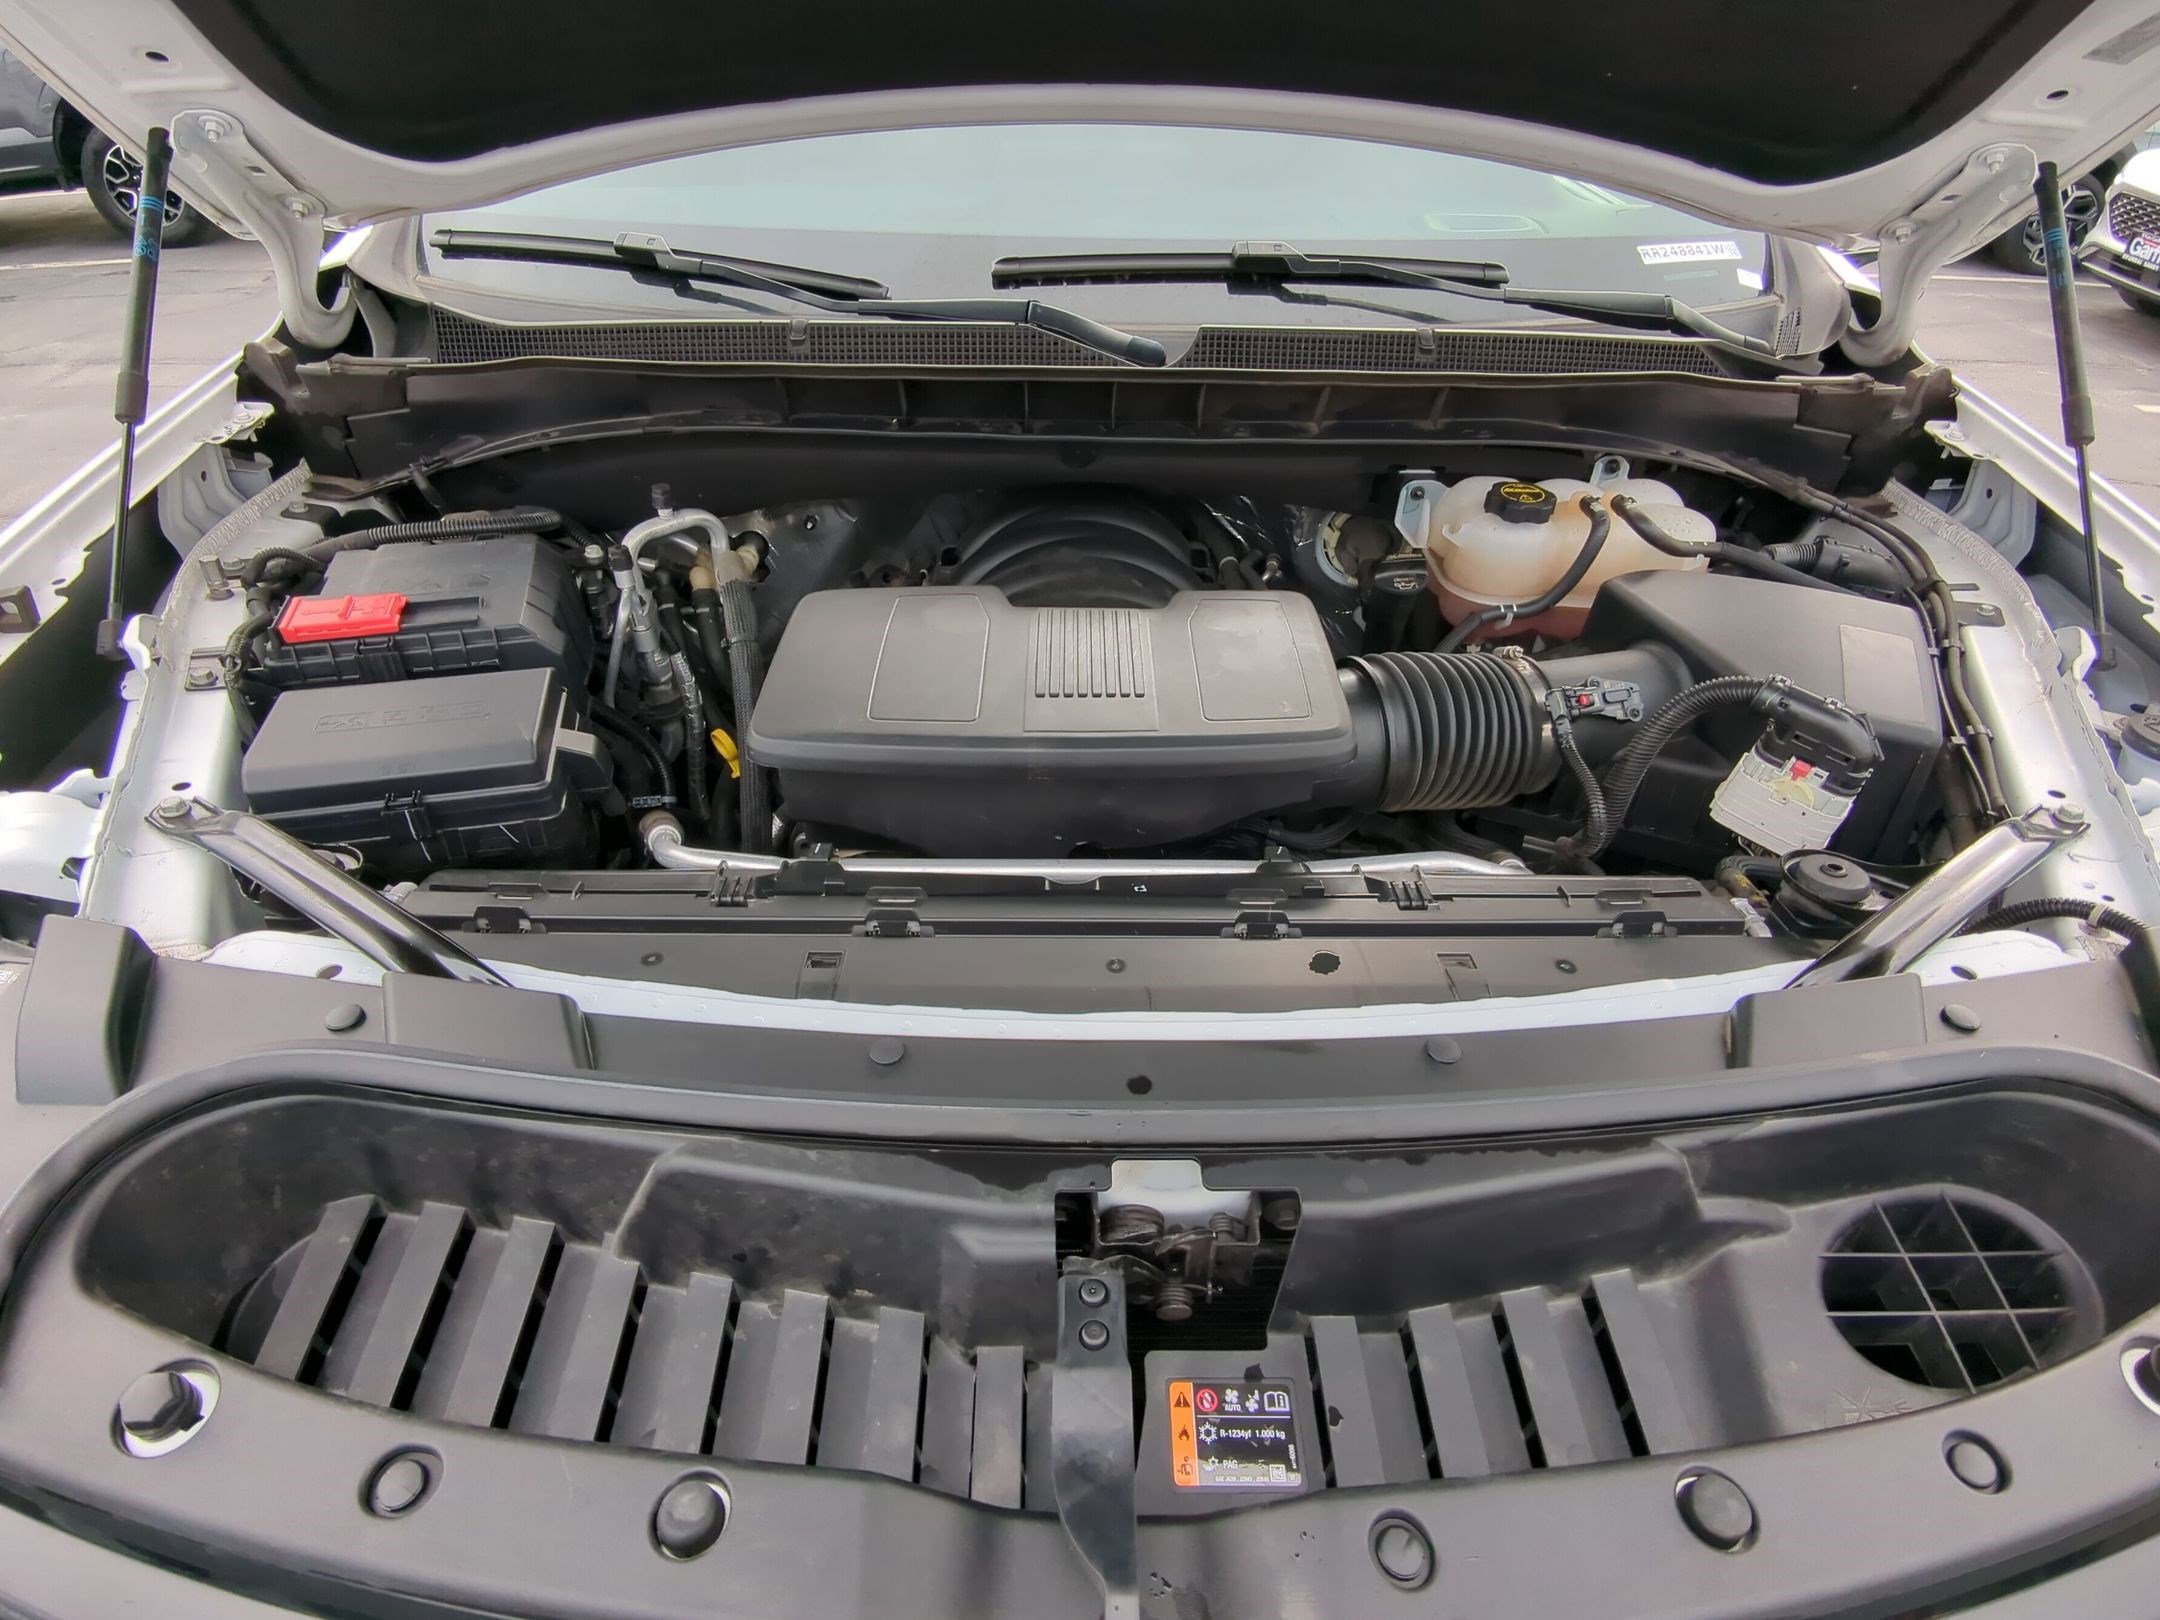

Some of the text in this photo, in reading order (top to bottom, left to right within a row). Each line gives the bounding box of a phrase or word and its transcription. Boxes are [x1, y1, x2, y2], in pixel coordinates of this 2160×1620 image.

[1220, 1429, 1286, 1440] R-1234yf 1.000 kg
[1223, 1460, 1238, 1469] PAG
